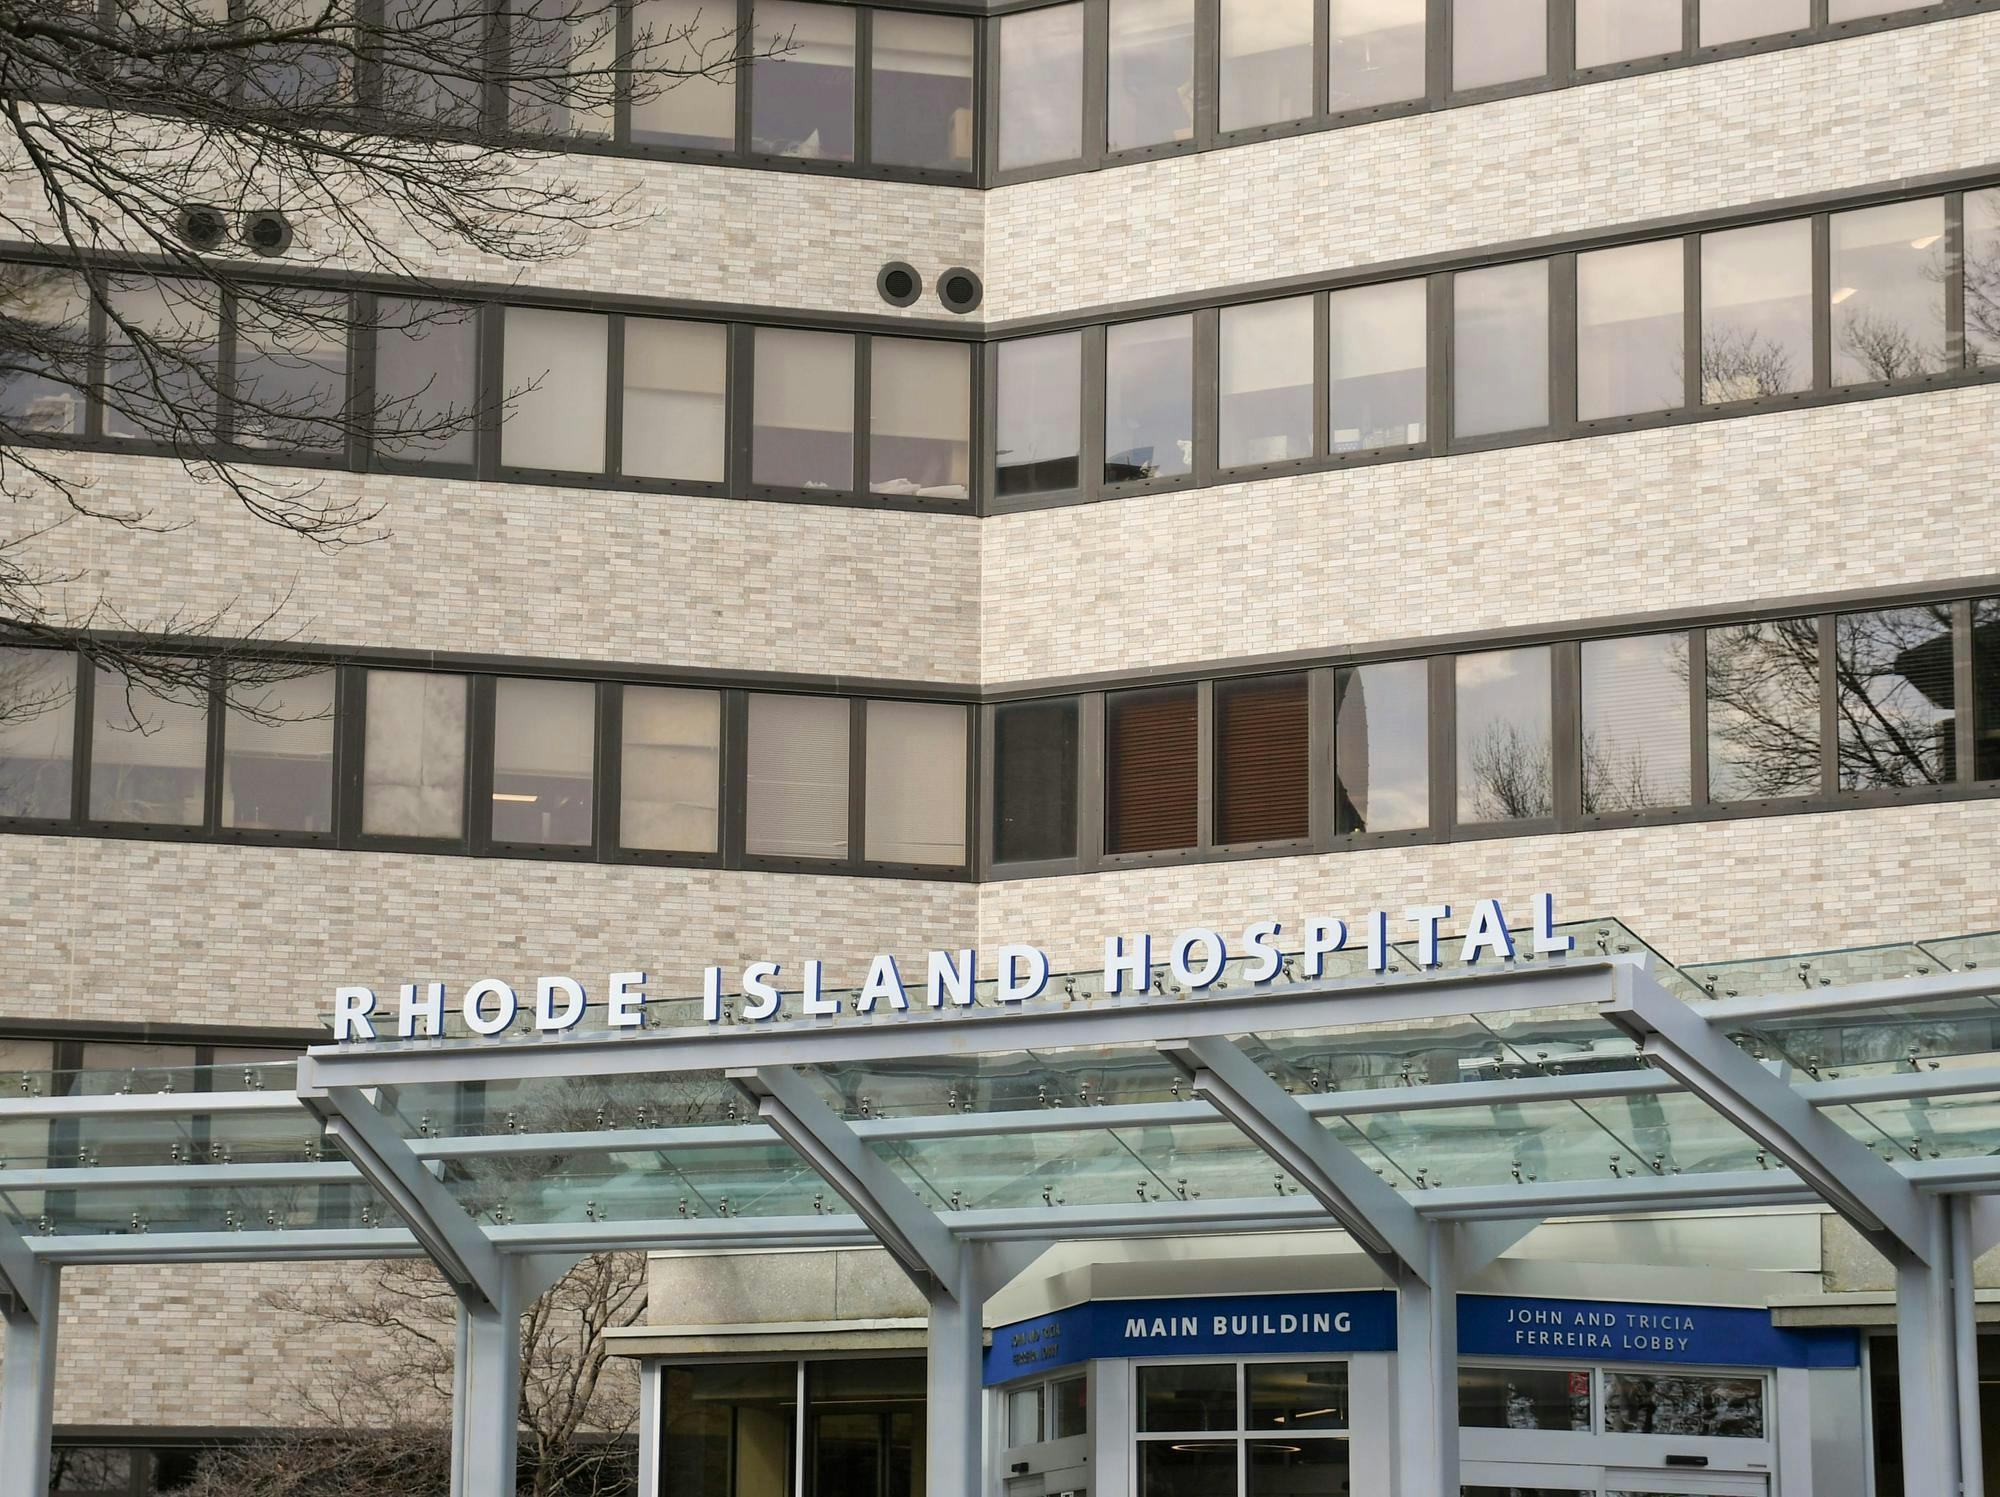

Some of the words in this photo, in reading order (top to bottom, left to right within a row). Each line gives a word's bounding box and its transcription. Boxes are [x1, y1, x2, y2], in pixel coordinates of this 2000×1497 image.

[333, 971, 647, 1041] RHODE
[703, 944, 1049, 1021] ISLAND
[1103, 893, 1575, 994] HOSPITAL
[1124, 1316, 1198, 1338] MAIN
[1213, 1312, 1351, 1336] BUILDING
[1507, 1309, 1562, 1325] JOHN
[1574, 1312, 1616, 1327] AND
[1626, 1314, 1694, 1330] TRICIA
[1515, 1330, 1612, 1348] FERREIRA
[1623, 1335, 1689, 1351] LOBBY
